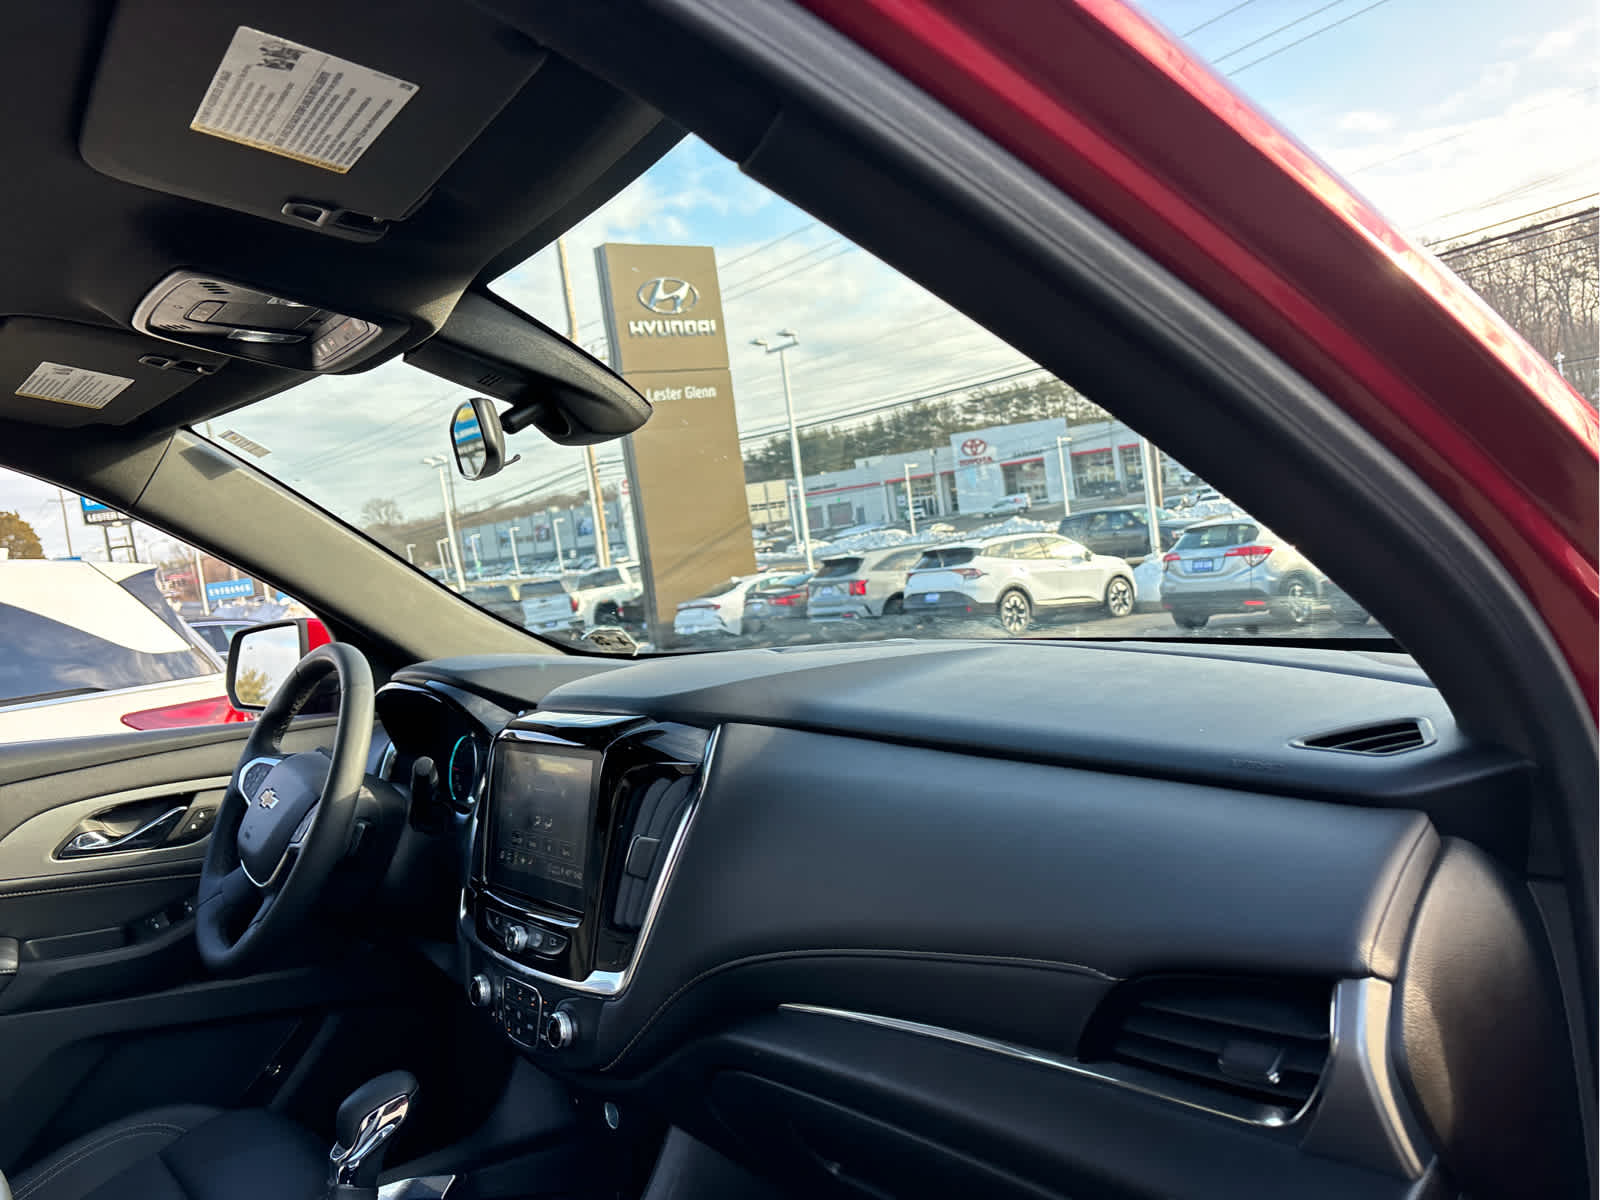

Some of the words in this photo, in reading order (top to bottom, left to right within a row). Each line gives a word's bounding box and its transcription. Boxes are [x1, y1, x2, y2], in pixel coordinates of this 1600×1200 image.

[629, 320, 717, 336] HYUNDAI
[646, 387, 682, 402] Lester
[685, 386, 717, 399] Glenn
